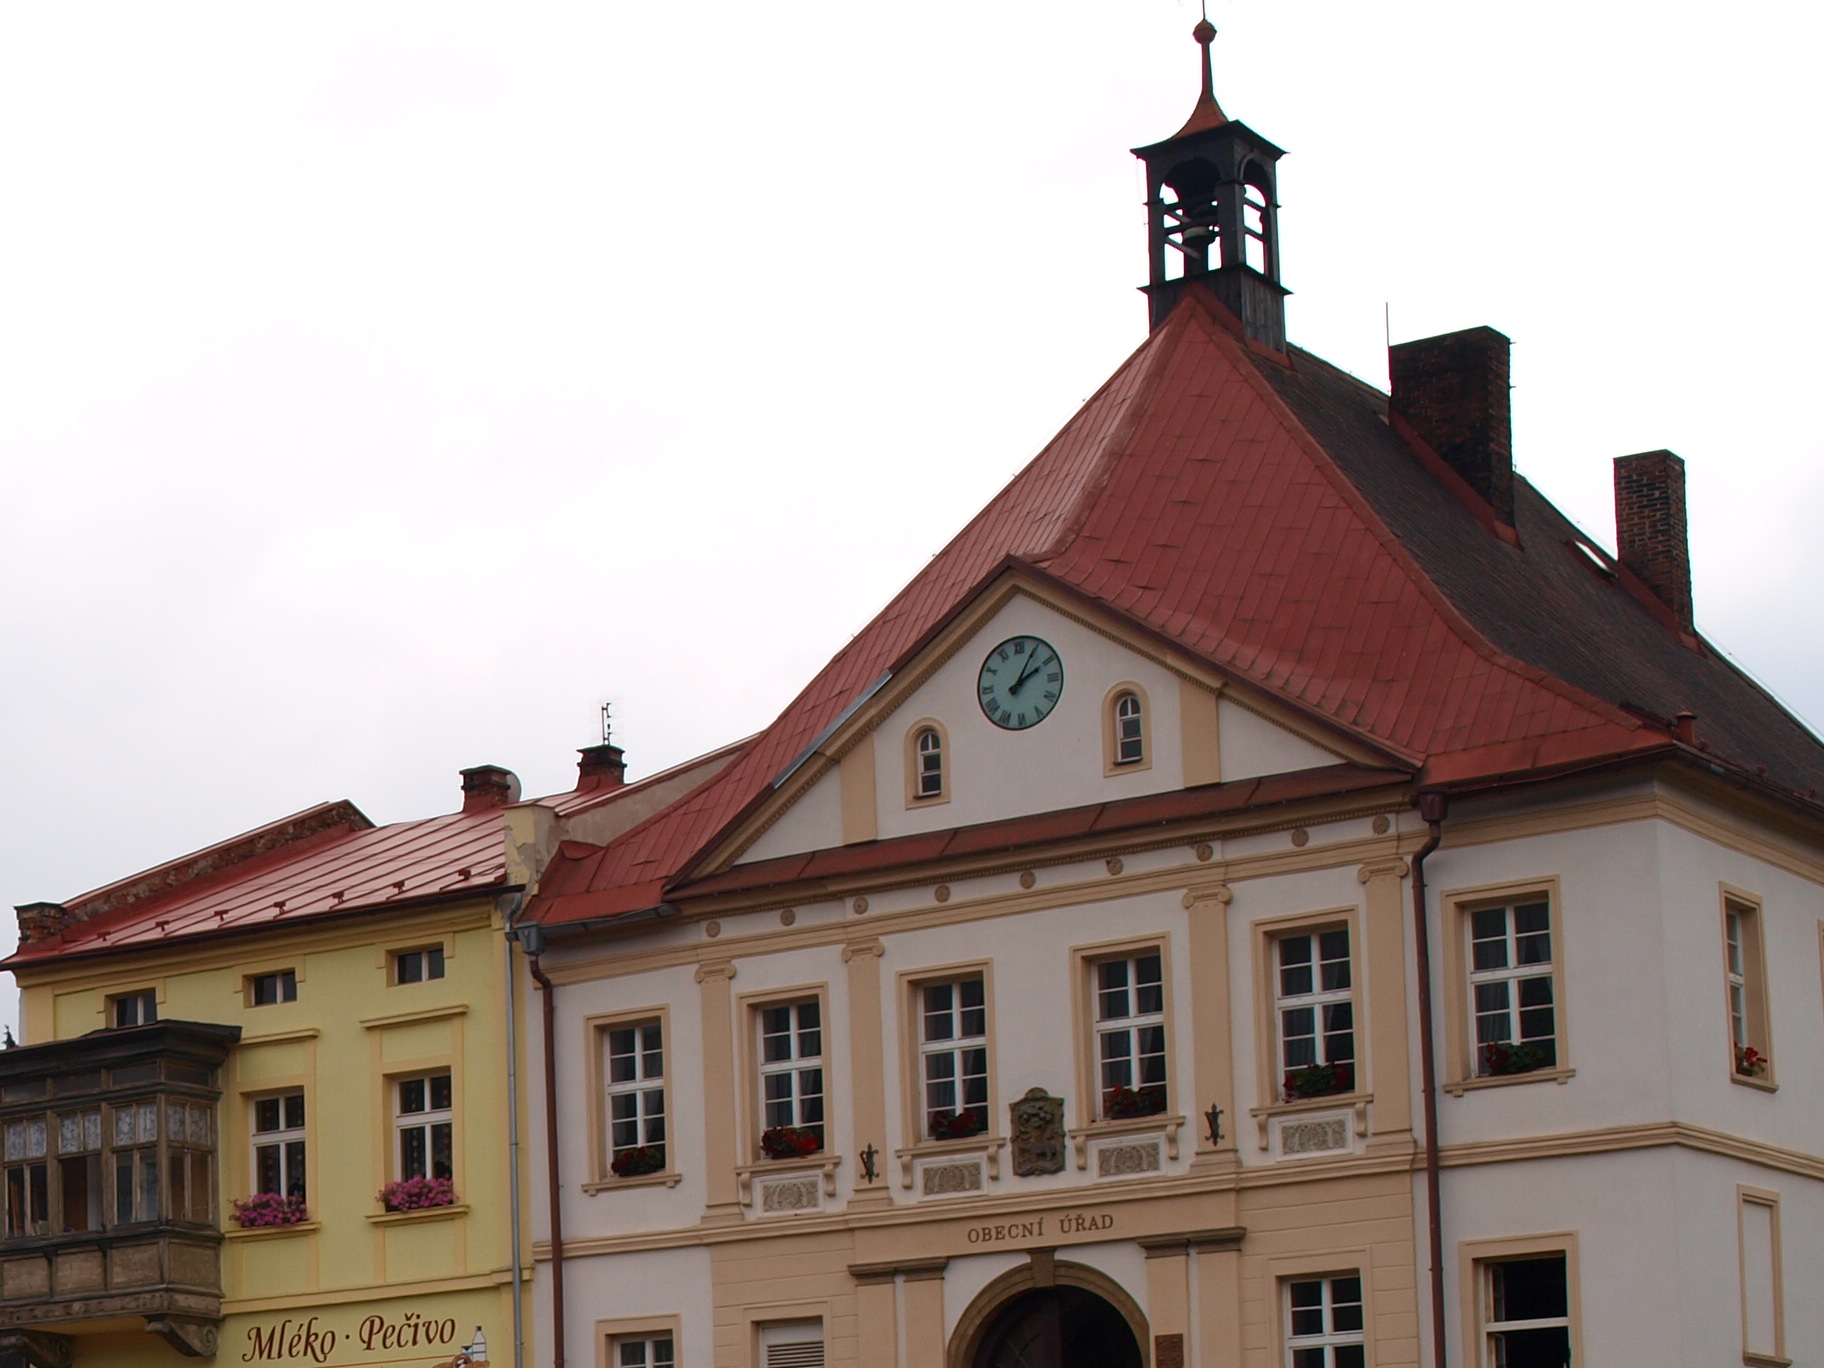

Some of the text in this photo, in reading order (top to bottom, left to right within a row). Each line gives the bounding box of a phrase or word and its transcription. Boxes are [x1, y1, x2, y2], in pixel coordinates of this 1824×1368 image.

[967, 1213, 1114, 1243] OBECNÍ ÚŘAD
[241, 1312, 456, 1364] Mléko Pečivo
